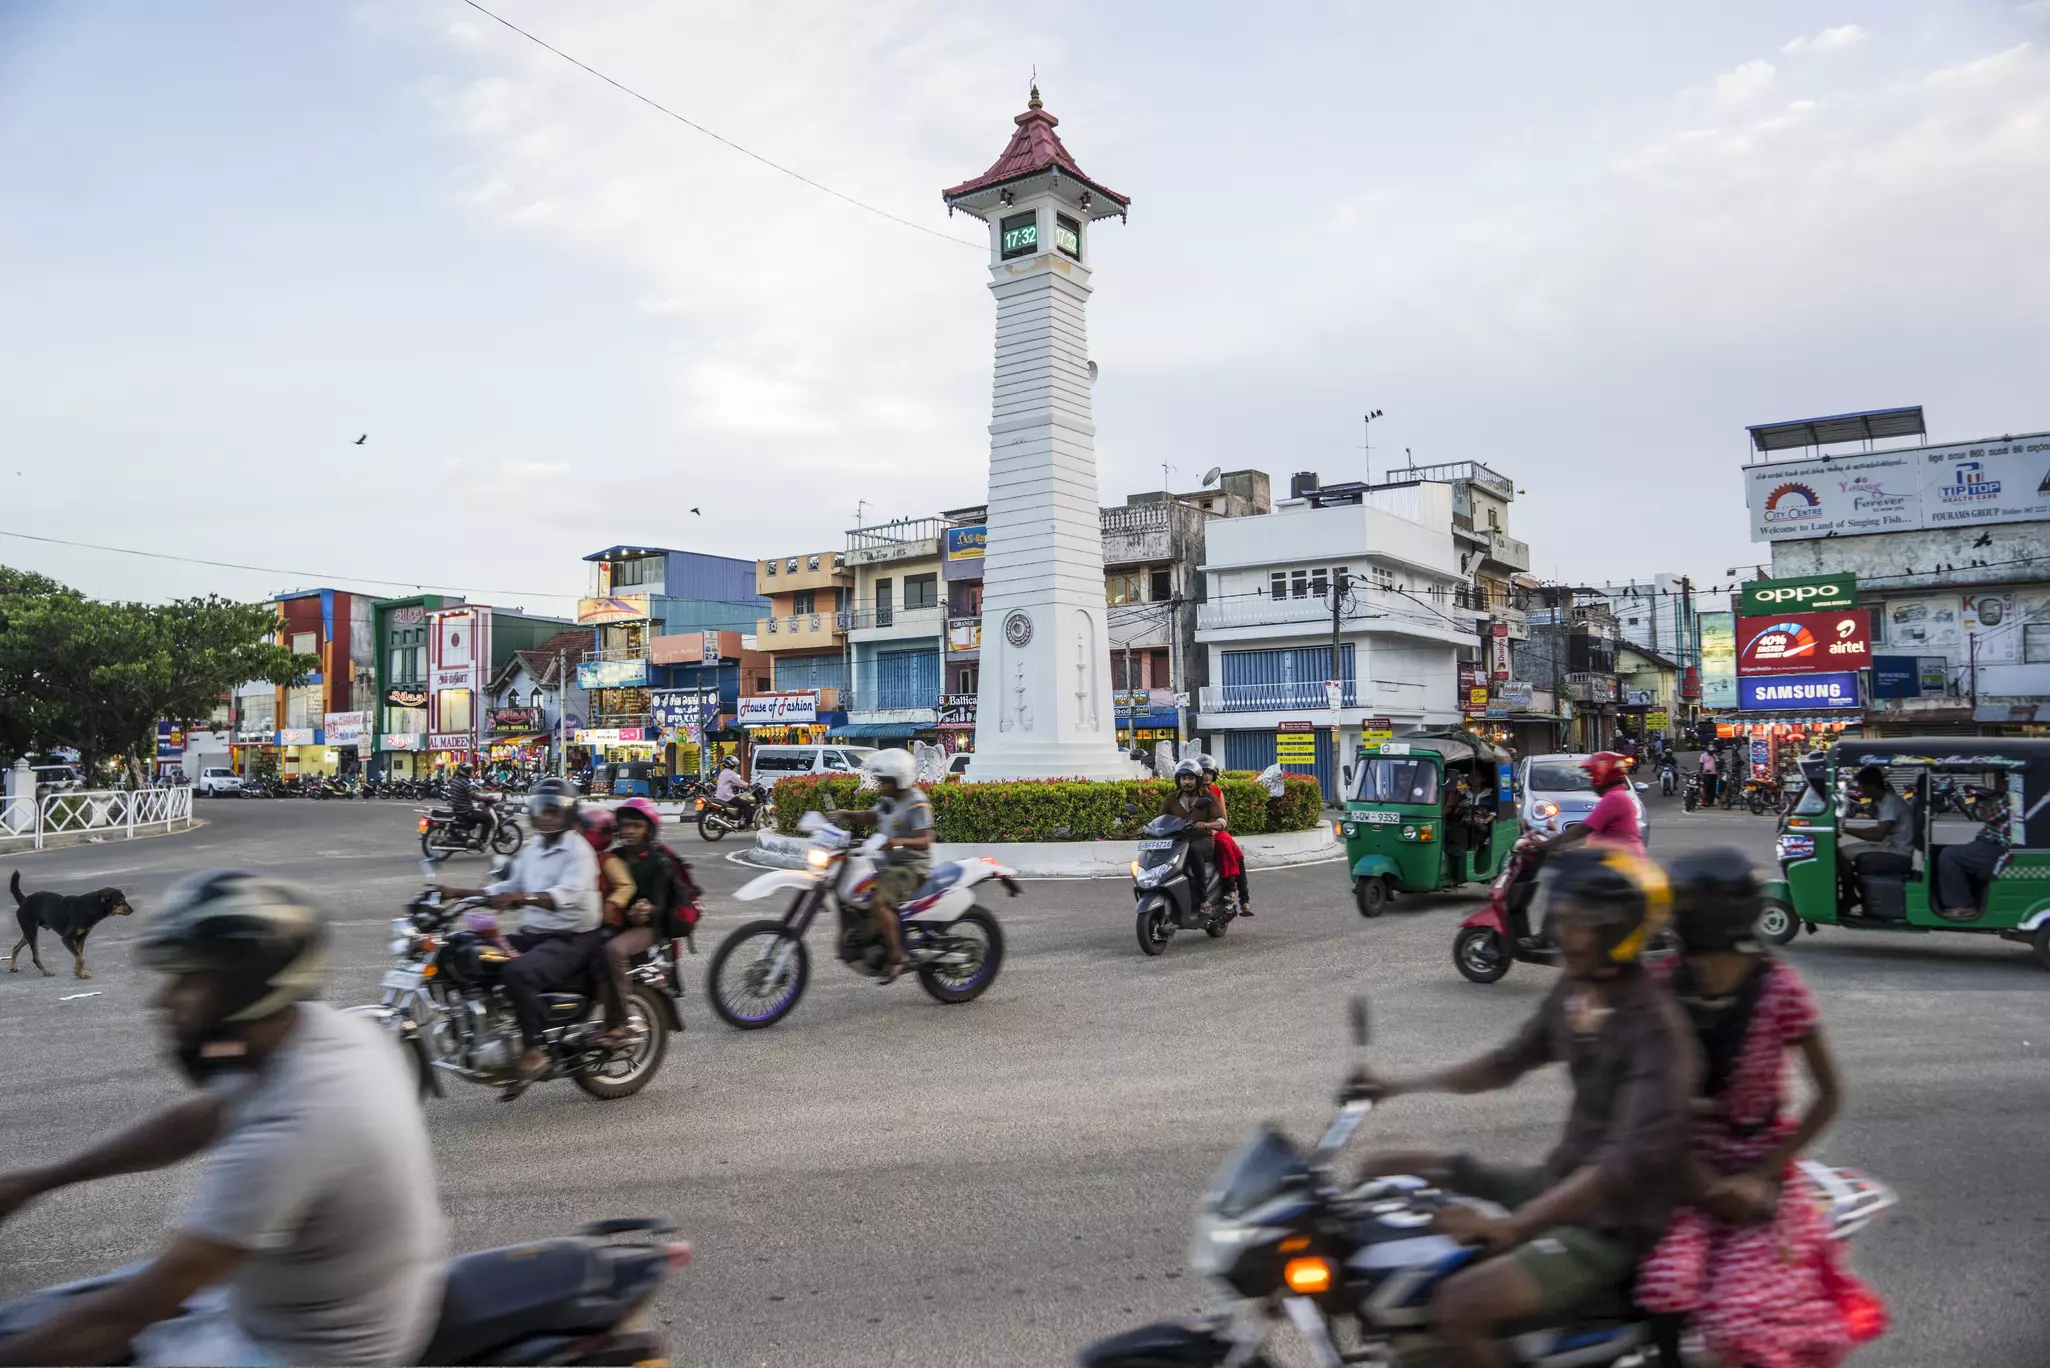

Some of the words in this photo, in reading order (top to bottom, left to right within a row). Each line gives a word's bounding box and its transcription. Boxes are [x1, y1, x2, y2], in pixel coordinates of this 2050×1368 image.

[1005, 227, 1037, 248] 17:32
[1056, 229, 1077, 252] 17:32
[1942, 486, 1967, 497] TIP
[1968, 482, 2000, 495] TOP
[1854, 497, 1905, 511] Forever
[1942, 495, 1975, 503] HEALTH
[1764, 510, 1785, 522] CITY
[1788, 508, 1823, 519] CENTRE
[1932, 510, 1970, 522] FOURAMS
[1971, 507, 2000, 518] GROUP
[1760, 525, 1797, 535] Welcome
[1799, 524, 1809, 532] to
[1811, 521, 1833, 531] Land
[1835, 519, 1845, 529] of
[1847, 517, 1880, 530] Singing
[1755, 585, 1840, 602] oppo
[1758, 634, 1787, 646] 40%
[1829, 640, 1866, 655] airtel
[1498, 638, 1506, 662] Dialog
[1755, 683, 1842, 701] SAMSUNG
[740, 699, 767, 717] House
[768, 698, 778, 719] of
[777, 697, 813, 717] Fashion
[430, 738, 439, 748] AL
[1377, 813, 1399, 823] 9352
